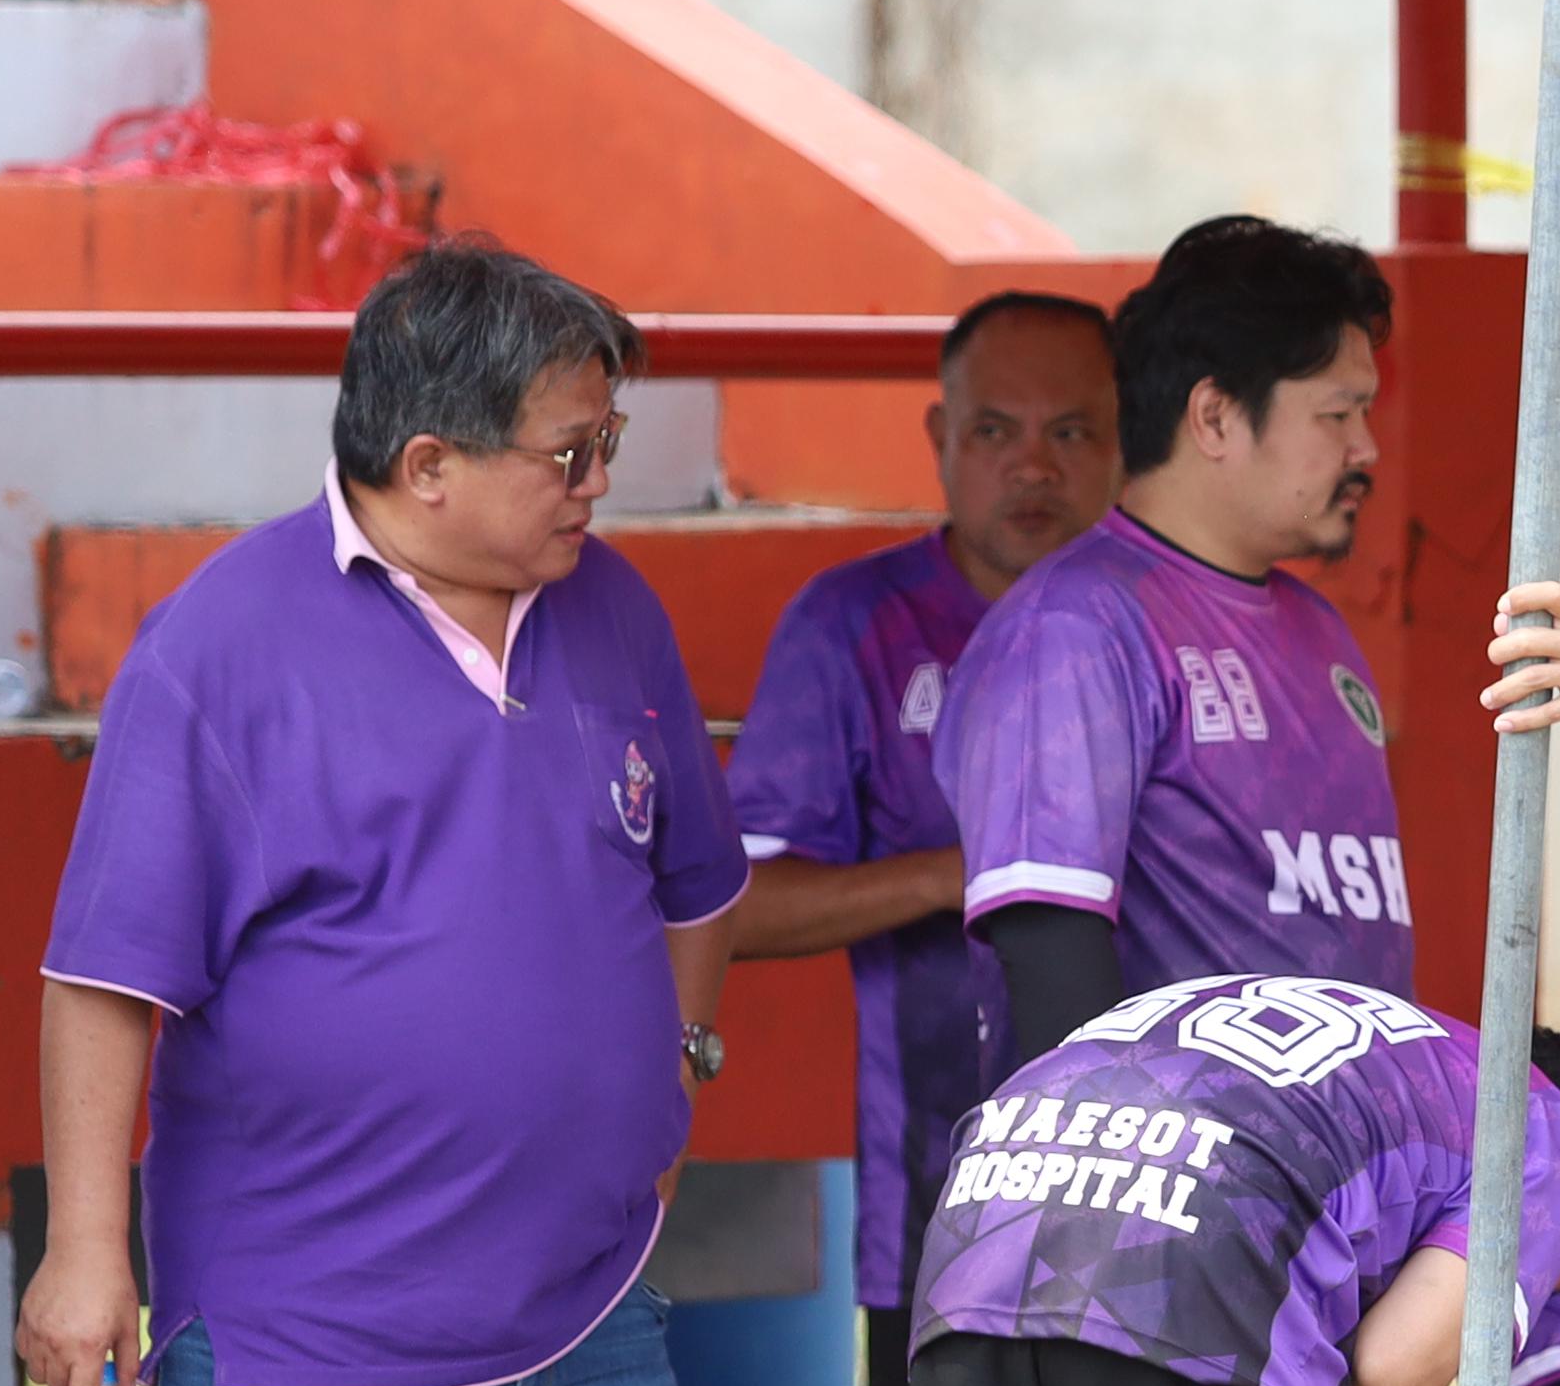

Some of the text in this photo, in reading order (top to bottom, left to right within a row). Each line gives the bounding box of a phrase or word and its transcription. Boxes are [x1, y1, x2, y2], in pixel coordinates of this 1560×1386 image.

[1262, 829, 1413, 928] MSH
[969, 1096, 1235, 1171] MAESOT
[944, 1150, 1200, 1235] HOSPITAL
